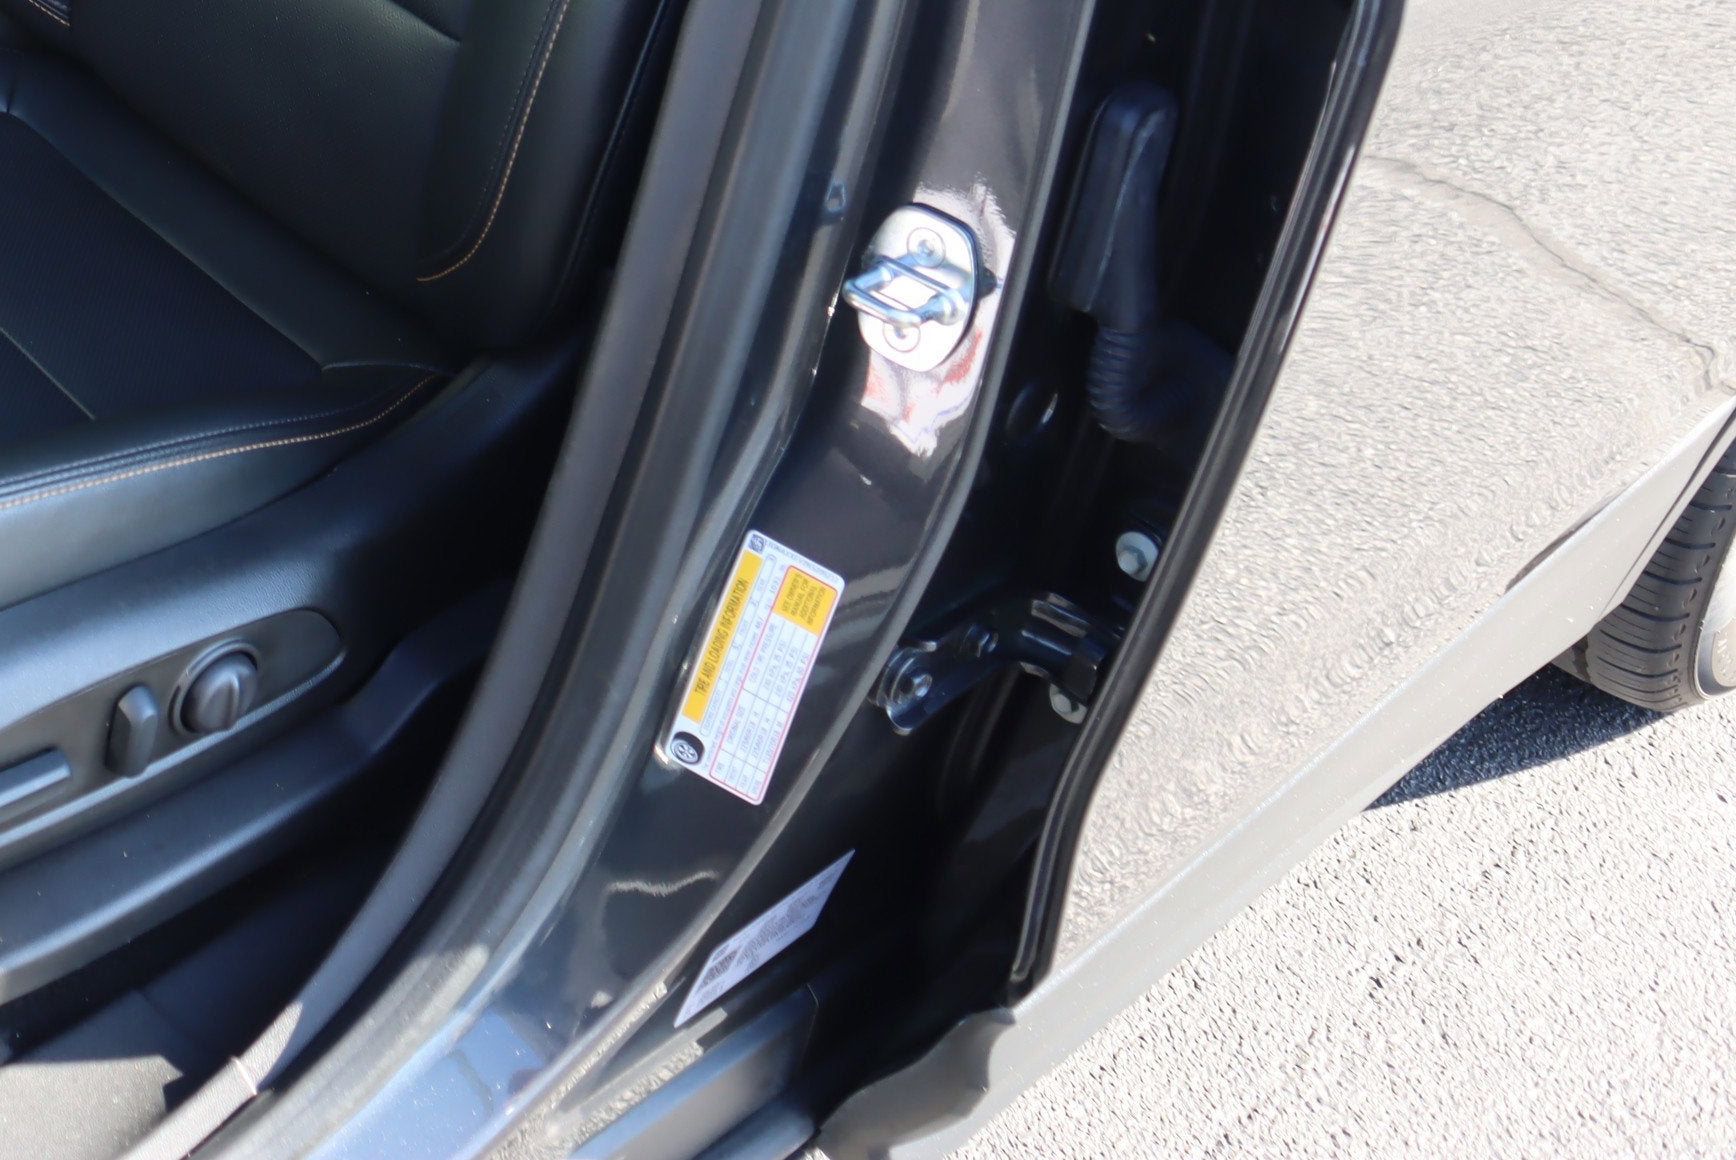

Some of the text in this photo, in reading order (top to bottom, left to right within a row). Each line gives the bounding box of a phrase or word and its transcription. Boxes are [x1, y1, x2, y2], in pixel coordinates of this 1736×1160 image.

[719, 576, 750, 632] INFORMATION
[706, 627, 730, 665] LOADING
[700, 660, 717, 681] AND
[694, 677, 710, 697] TIRE
